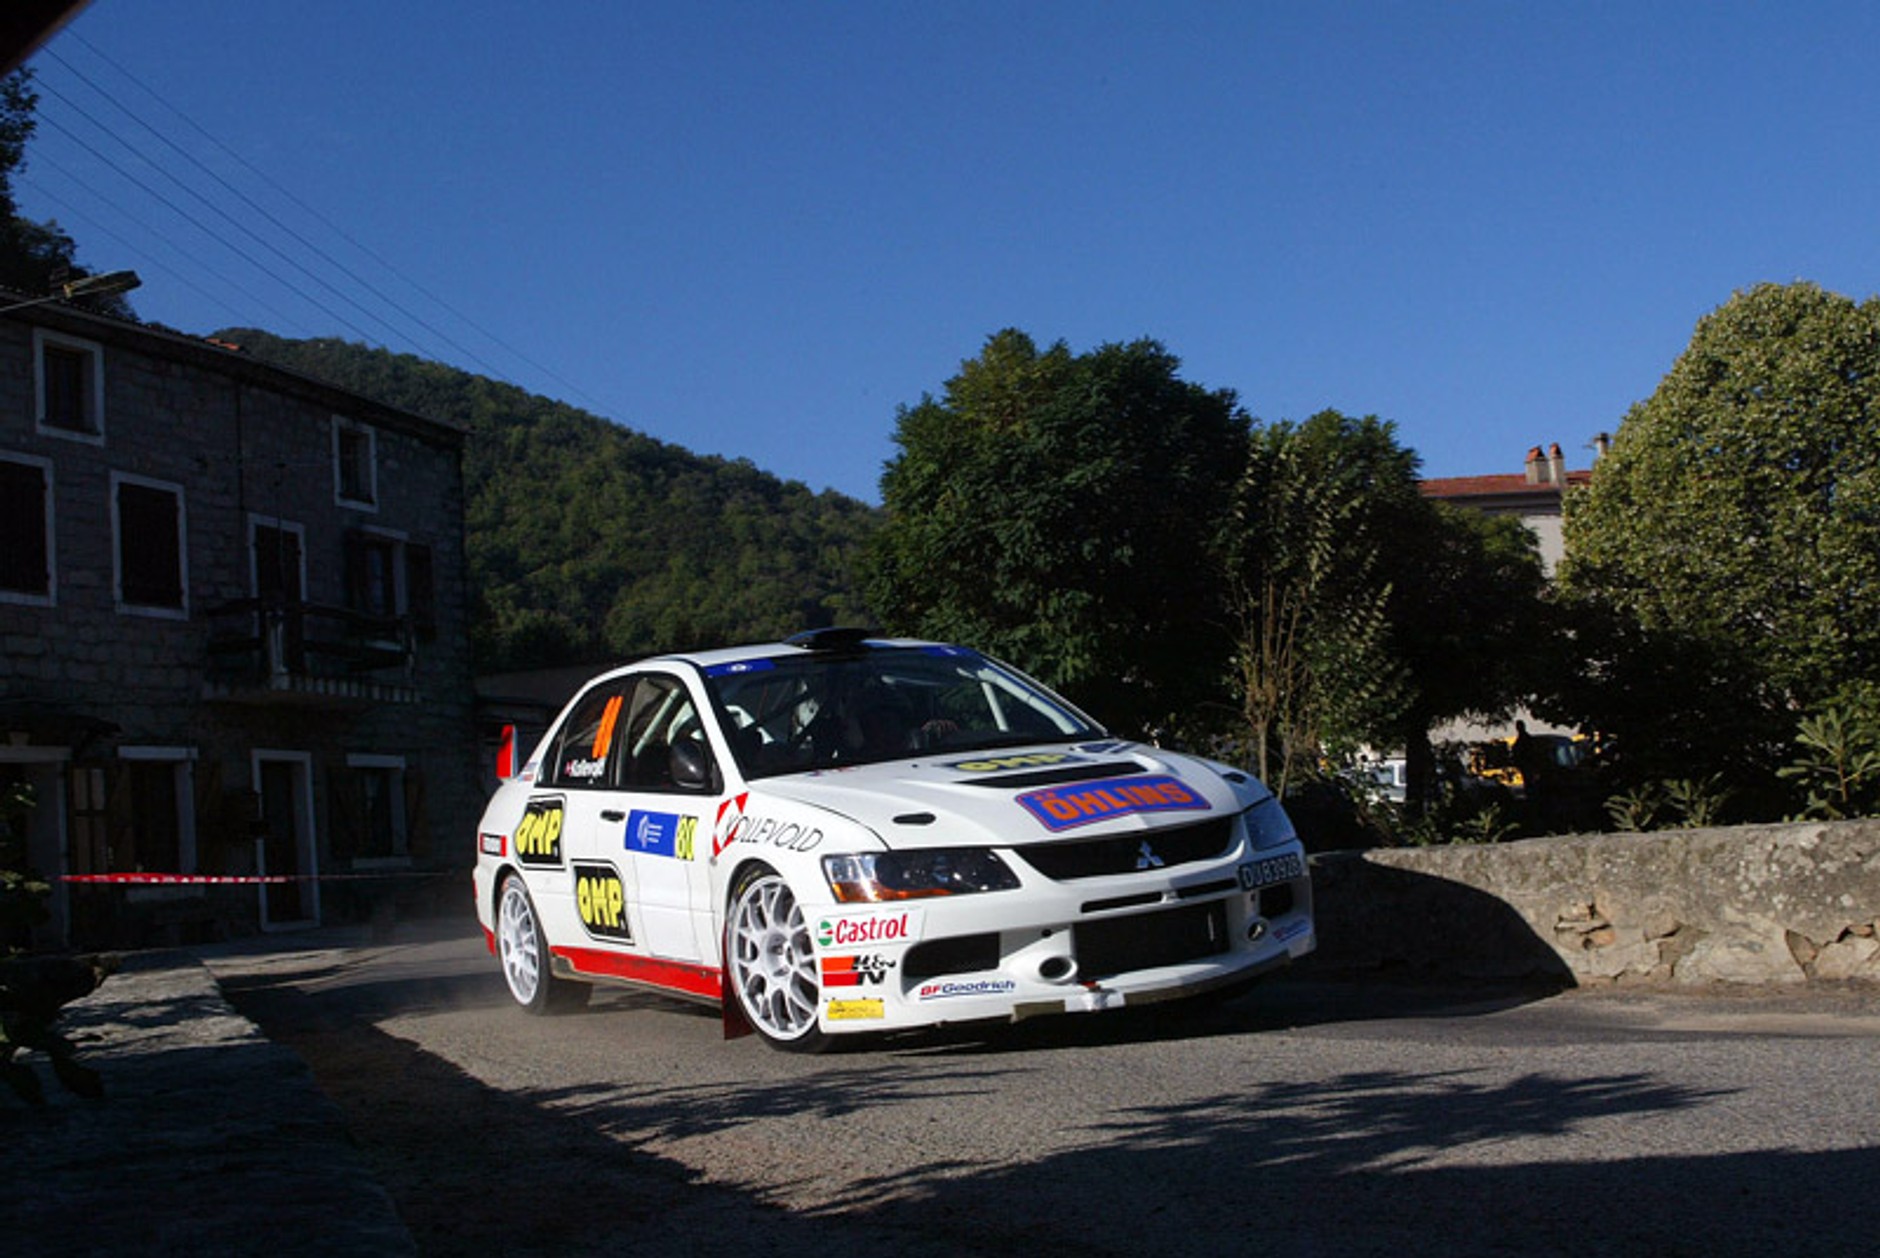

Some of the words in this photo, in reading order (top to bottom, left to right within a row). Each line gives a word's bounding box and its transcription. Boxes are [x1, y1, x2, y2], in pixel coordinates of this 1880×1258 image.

[956, 753, 1067, 772] OMP
[1036, 782, 1195, 821] ÖHLINS
[514, 808, 563, 855] OMP
[725, 813, 825, 852] KOLLEVOLD
[577, 876, 623, 928] OMP
[835, 913, 908, 944] Castrol
[920, 980, 1016, 996] BFGoodrich
